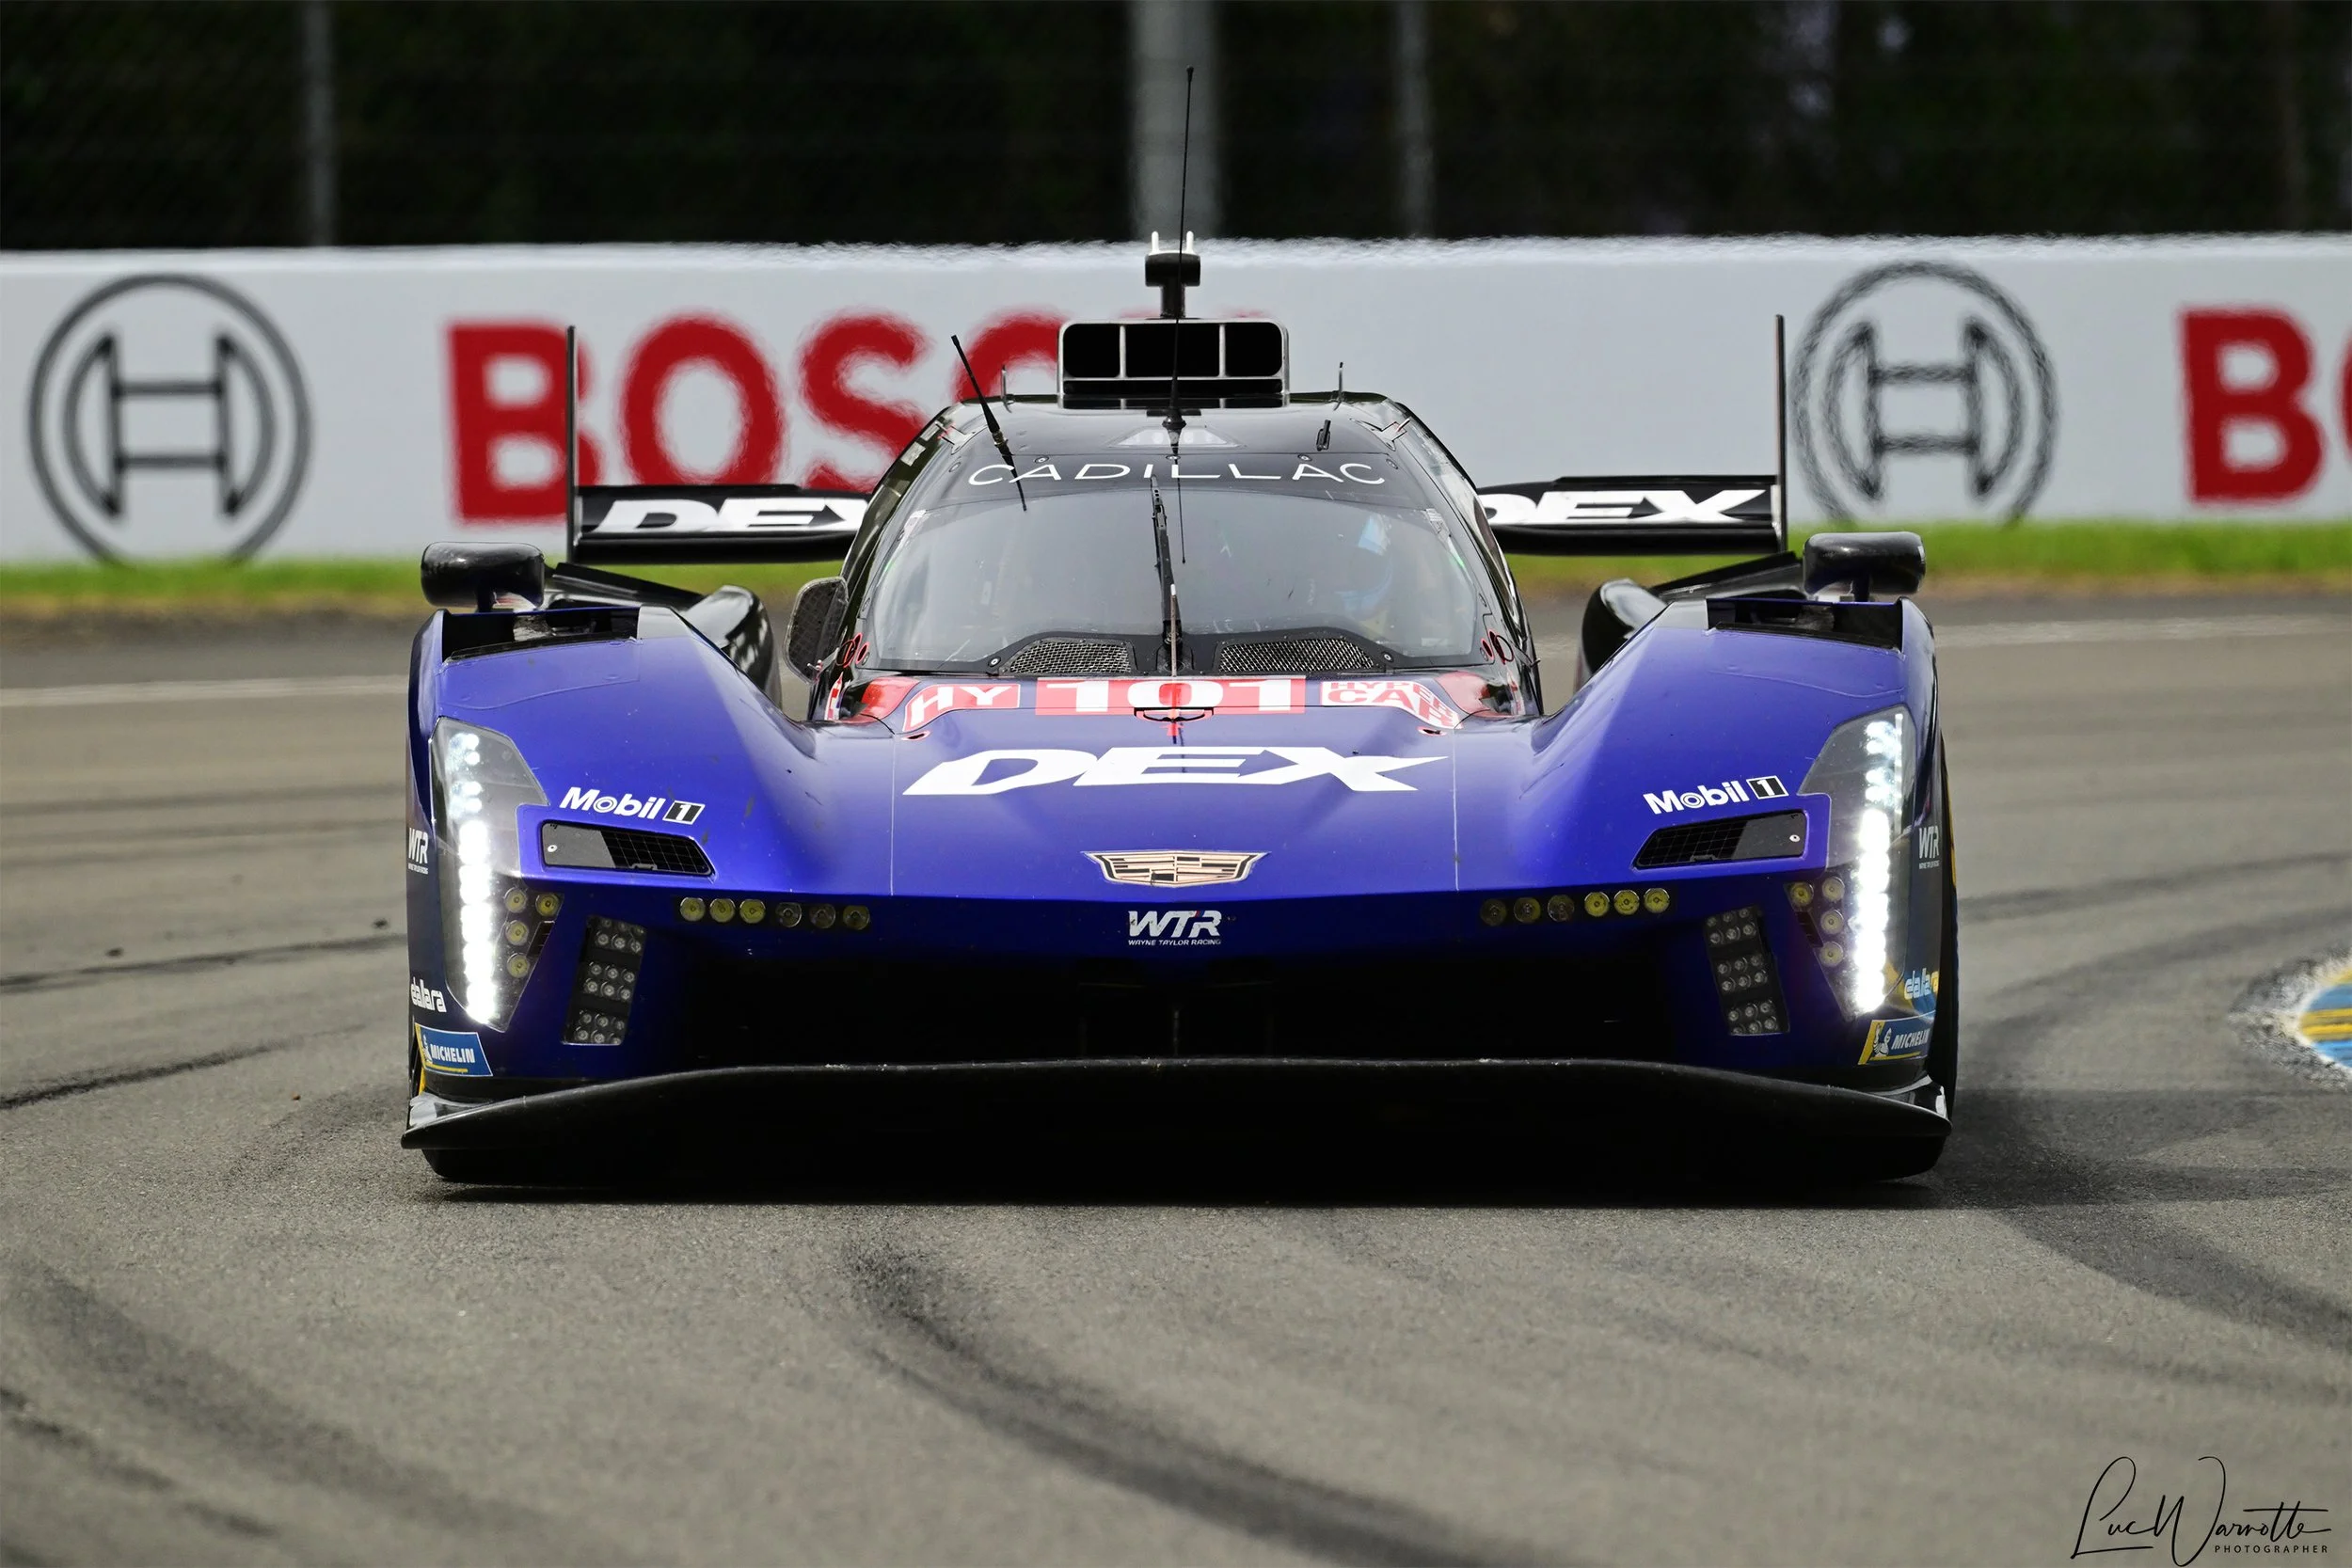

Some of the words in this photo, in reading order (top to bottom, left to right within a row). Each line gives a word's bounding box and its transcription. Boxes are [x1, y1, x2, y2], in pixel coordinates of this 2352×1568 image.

[2177, 306, 2352, 504] B
[968, 463, 1385, 486] CADILLAC
[910, 686, 1012, 727] HY
[1046, 679, 1293, 714] 101
[1327, 689, 1455, 726] CAR
[902, 746, 1449, 795] DEX
[559, 786, 666, 820] Mobil
[1643, 780, 1750, 815] Mobil
[408, 827, 429, 864] WTR
[1918, 825, 1940, 859] WTR
[1128, 910, 1222, 938] WTR
[430, 1043, 476, 1064] MICHELIN
[1891, 1028, 1931, 1051] MICHELIN
